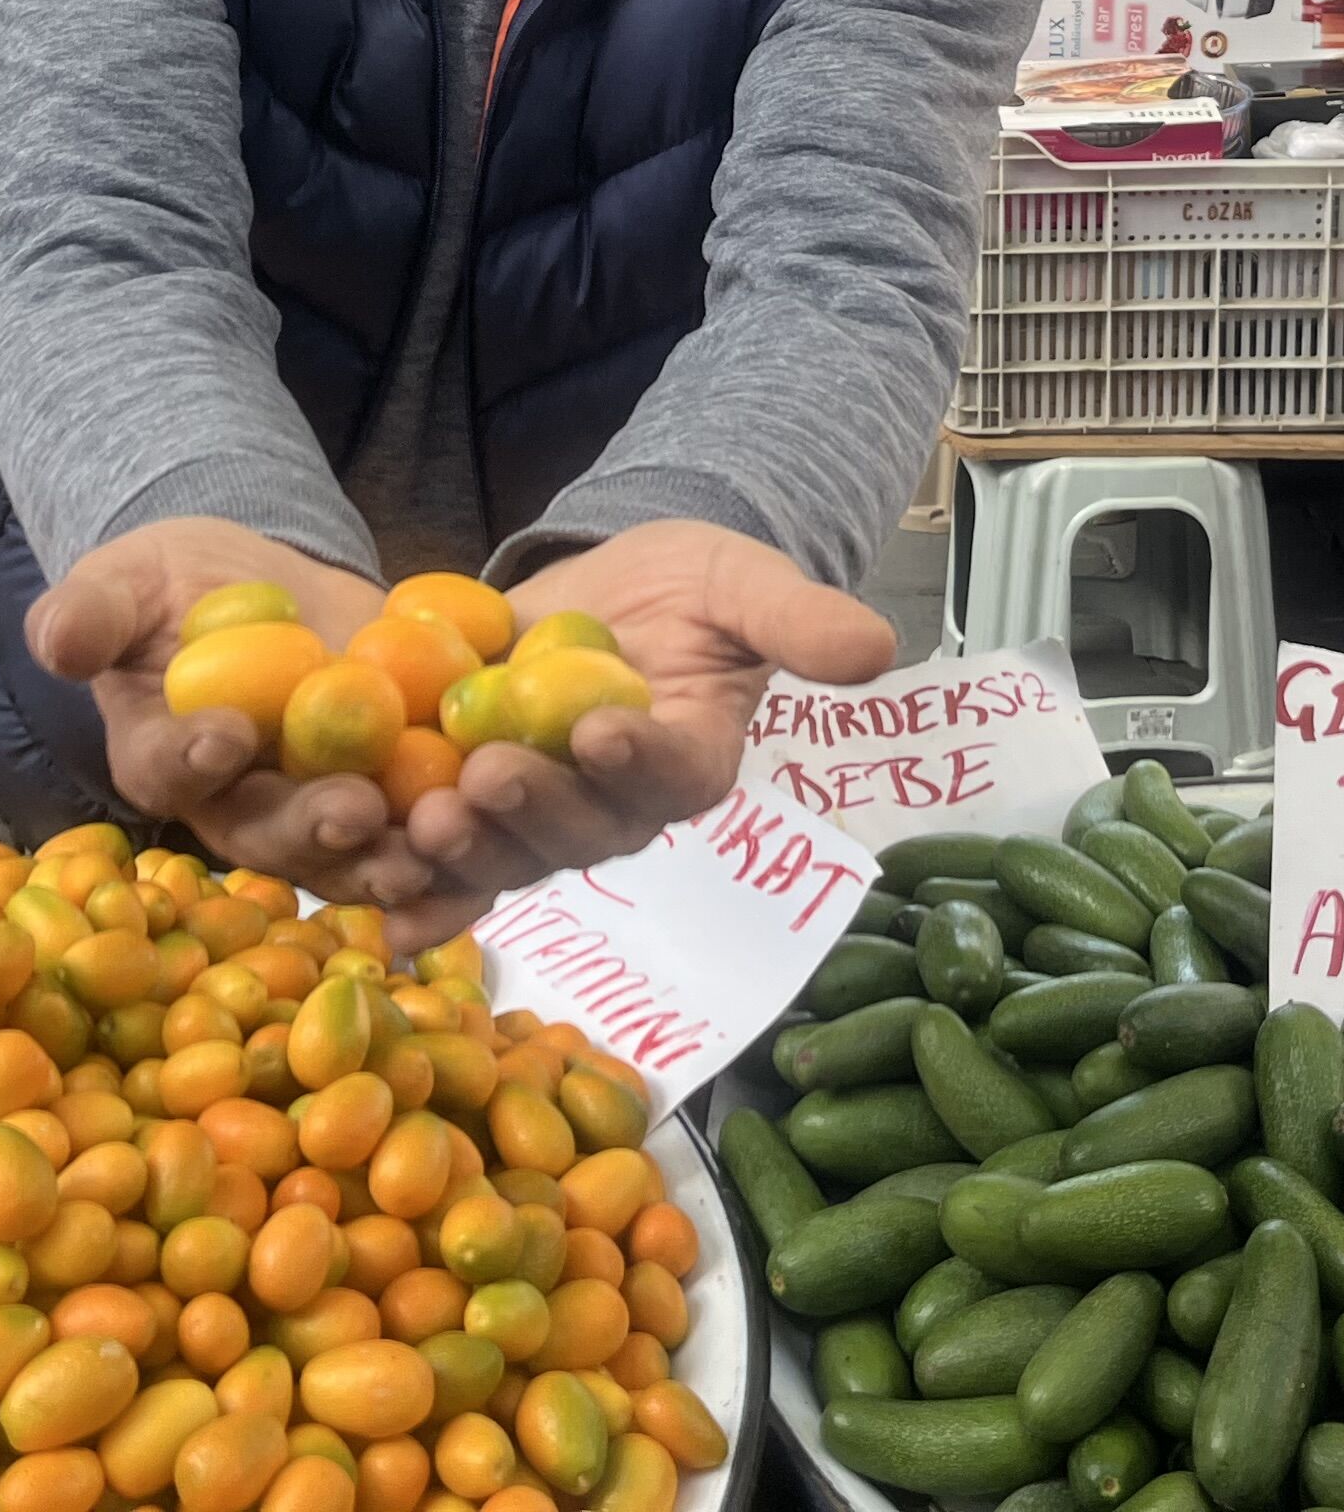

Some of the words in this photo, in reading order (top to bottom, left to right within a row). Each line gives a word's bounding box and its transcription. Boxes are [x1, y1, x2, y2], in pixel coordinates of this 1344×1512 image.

[1049, 18, 1064, 58] LUX
[1096, 7, 1110, 33] Nar
[1128, 8, 1143, 52] Presi
[771, 742, 1000, 816] BEBE
